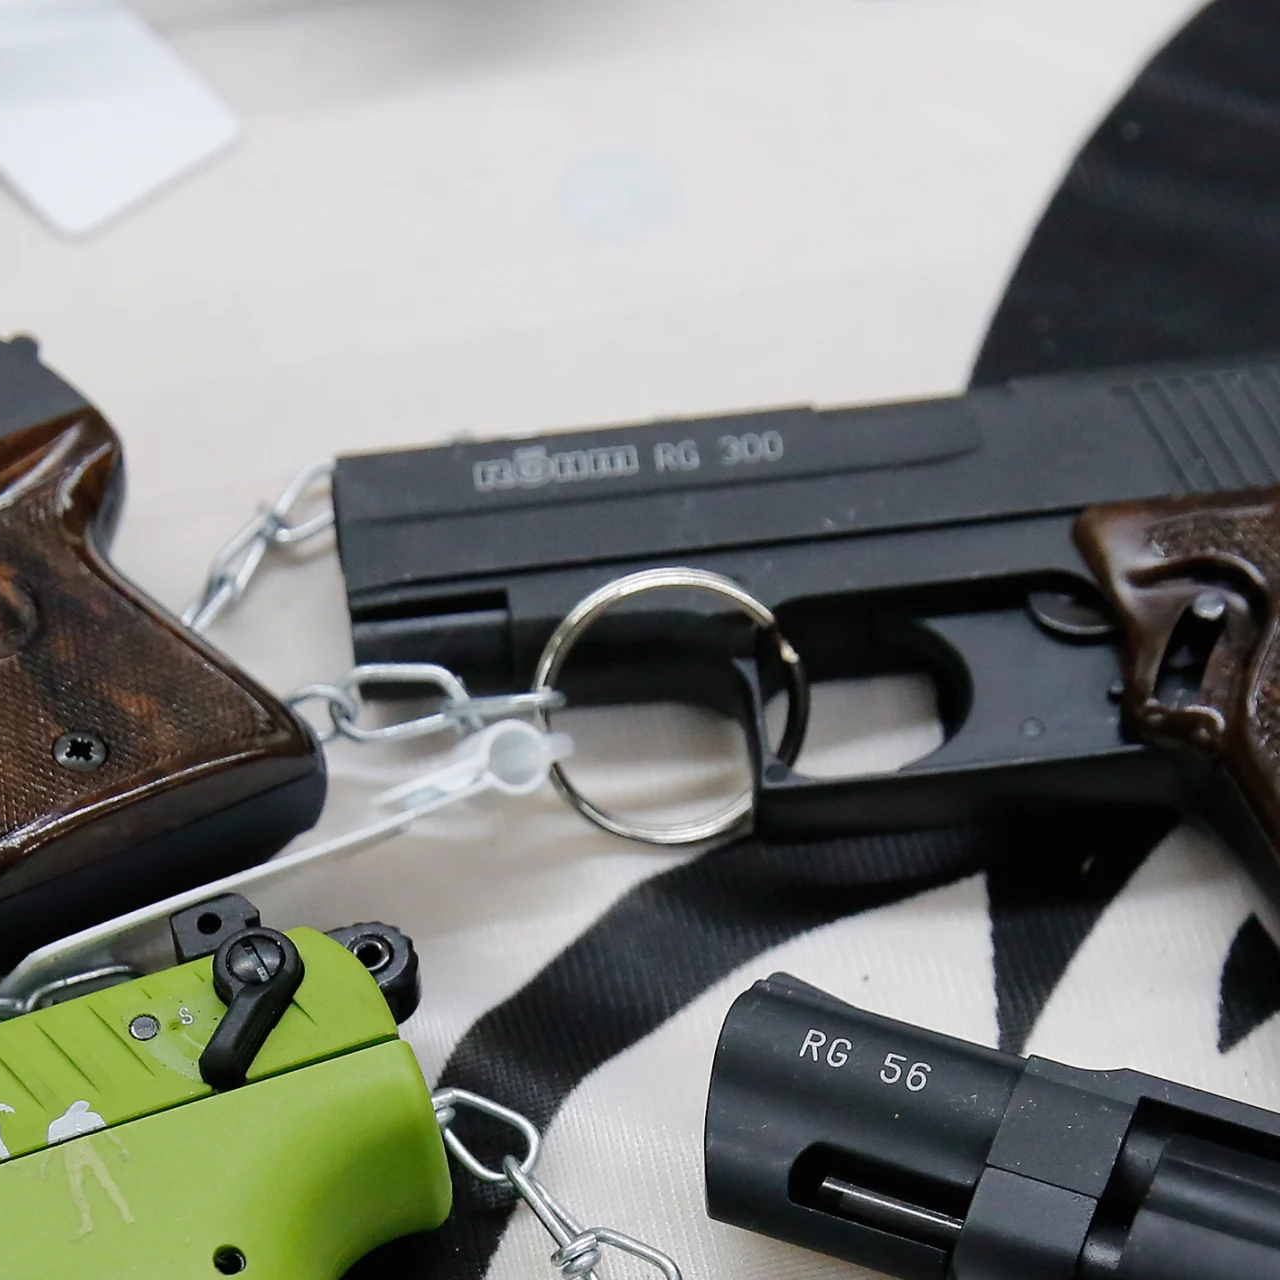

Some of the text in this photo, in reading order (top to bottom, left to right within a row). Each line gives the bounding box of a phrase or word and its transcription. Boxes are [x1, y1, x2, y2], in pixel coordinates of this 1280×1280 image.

[654, 441, 700, 474] RG
[718, 430, 784, 466] 300
[178, 1006, 194, 1025] S
[799, 1028, 933, 1092] RG 56
